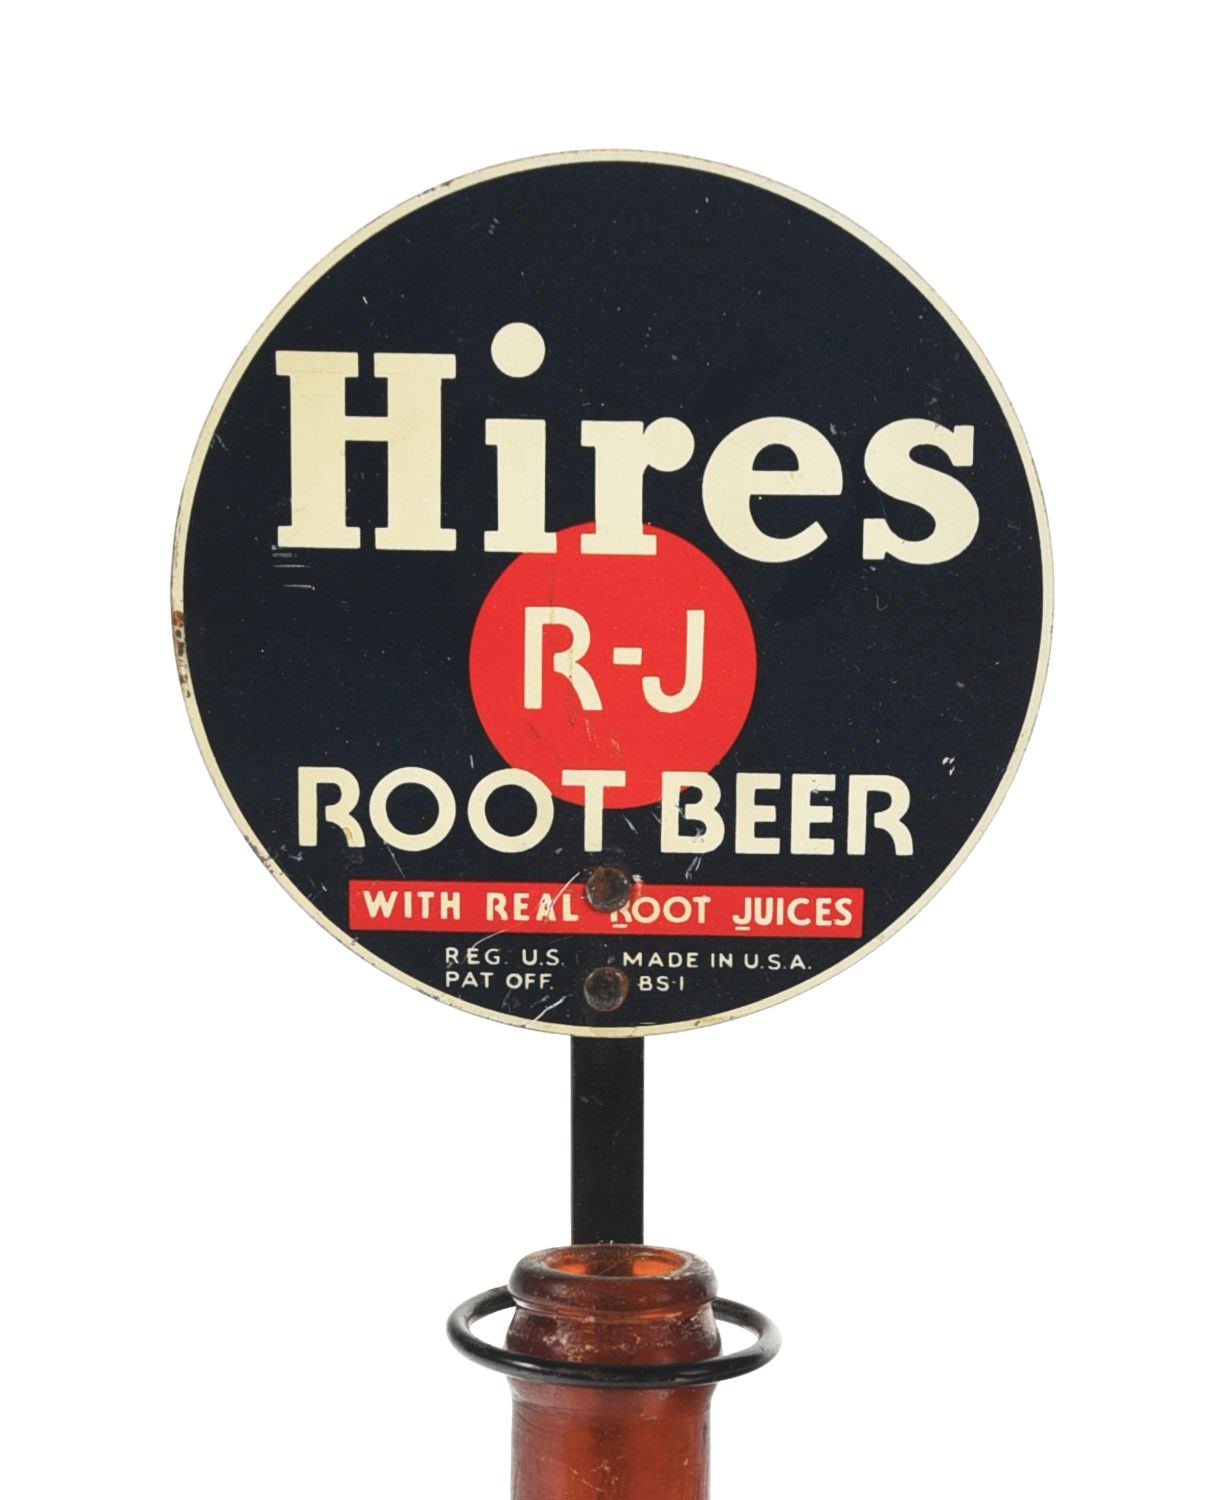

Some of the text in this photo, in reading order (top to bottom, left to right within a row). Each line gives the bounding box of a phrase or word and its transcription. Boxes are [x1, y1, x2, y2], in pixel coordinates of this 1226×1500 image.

[276, 321, 980, 566] Hires
[523, 606, 705, 714] R-J
[297, 766, 914, 856] ROOT BEER
[363, 890, 461, 920] WITH
[486, 892, 579, 922] REAL
[731, 896, 853, 932] JUICES
[522, 948, 565, 967] U.S.
[622, 951, 812, 971] MADE IN U.S.A.
[445, 970, 554, 991] PAT OFF.
